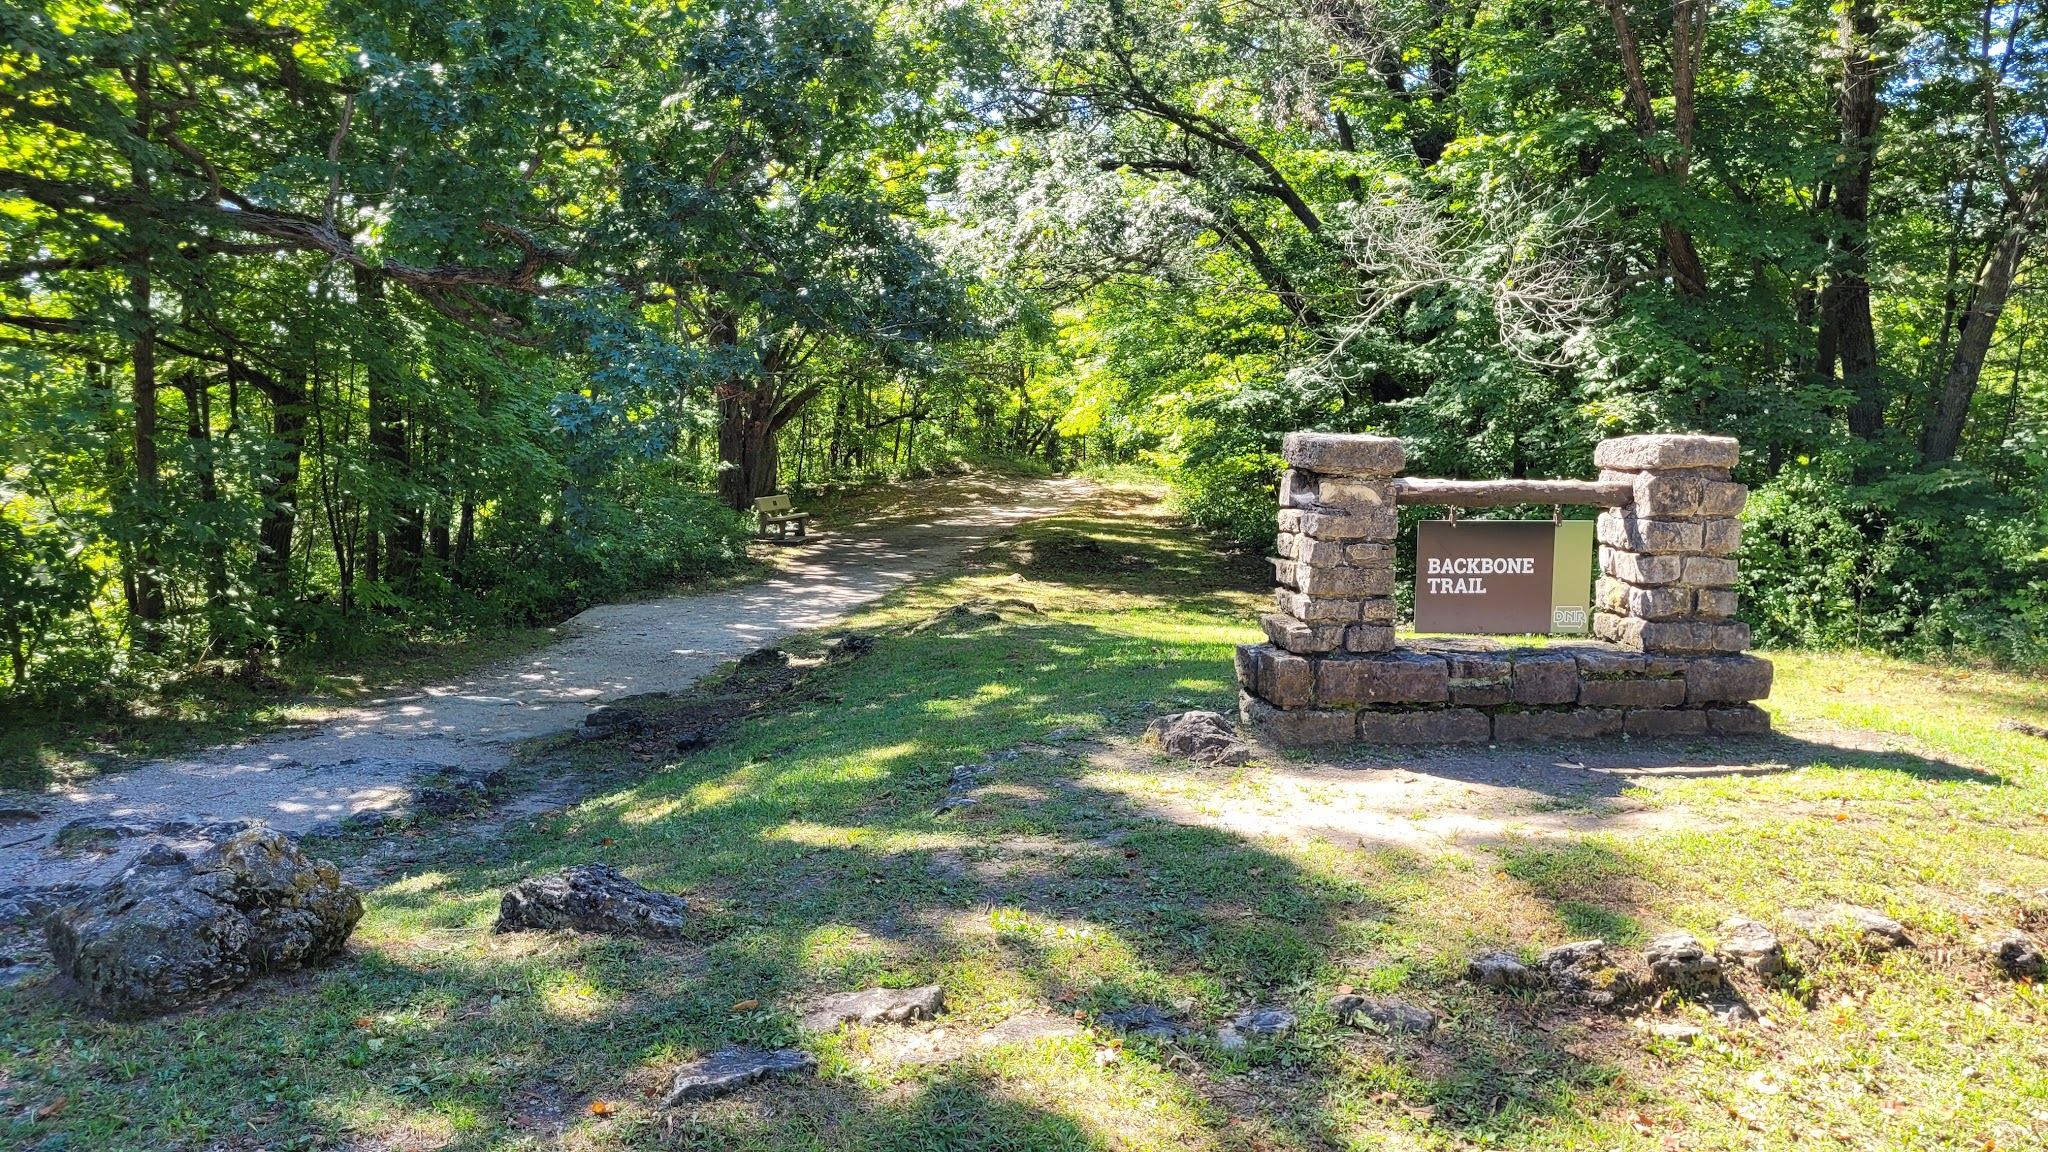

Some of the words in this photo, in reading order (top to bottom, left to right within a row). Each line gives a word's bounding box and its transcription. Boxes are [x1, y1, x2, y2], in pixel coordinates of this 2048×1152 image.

[1427, 558, 1535, 574] BACKBONE
[1427, 578, 1487, 594] TRAIL
[1553, 610, 1587, 624] DNR
